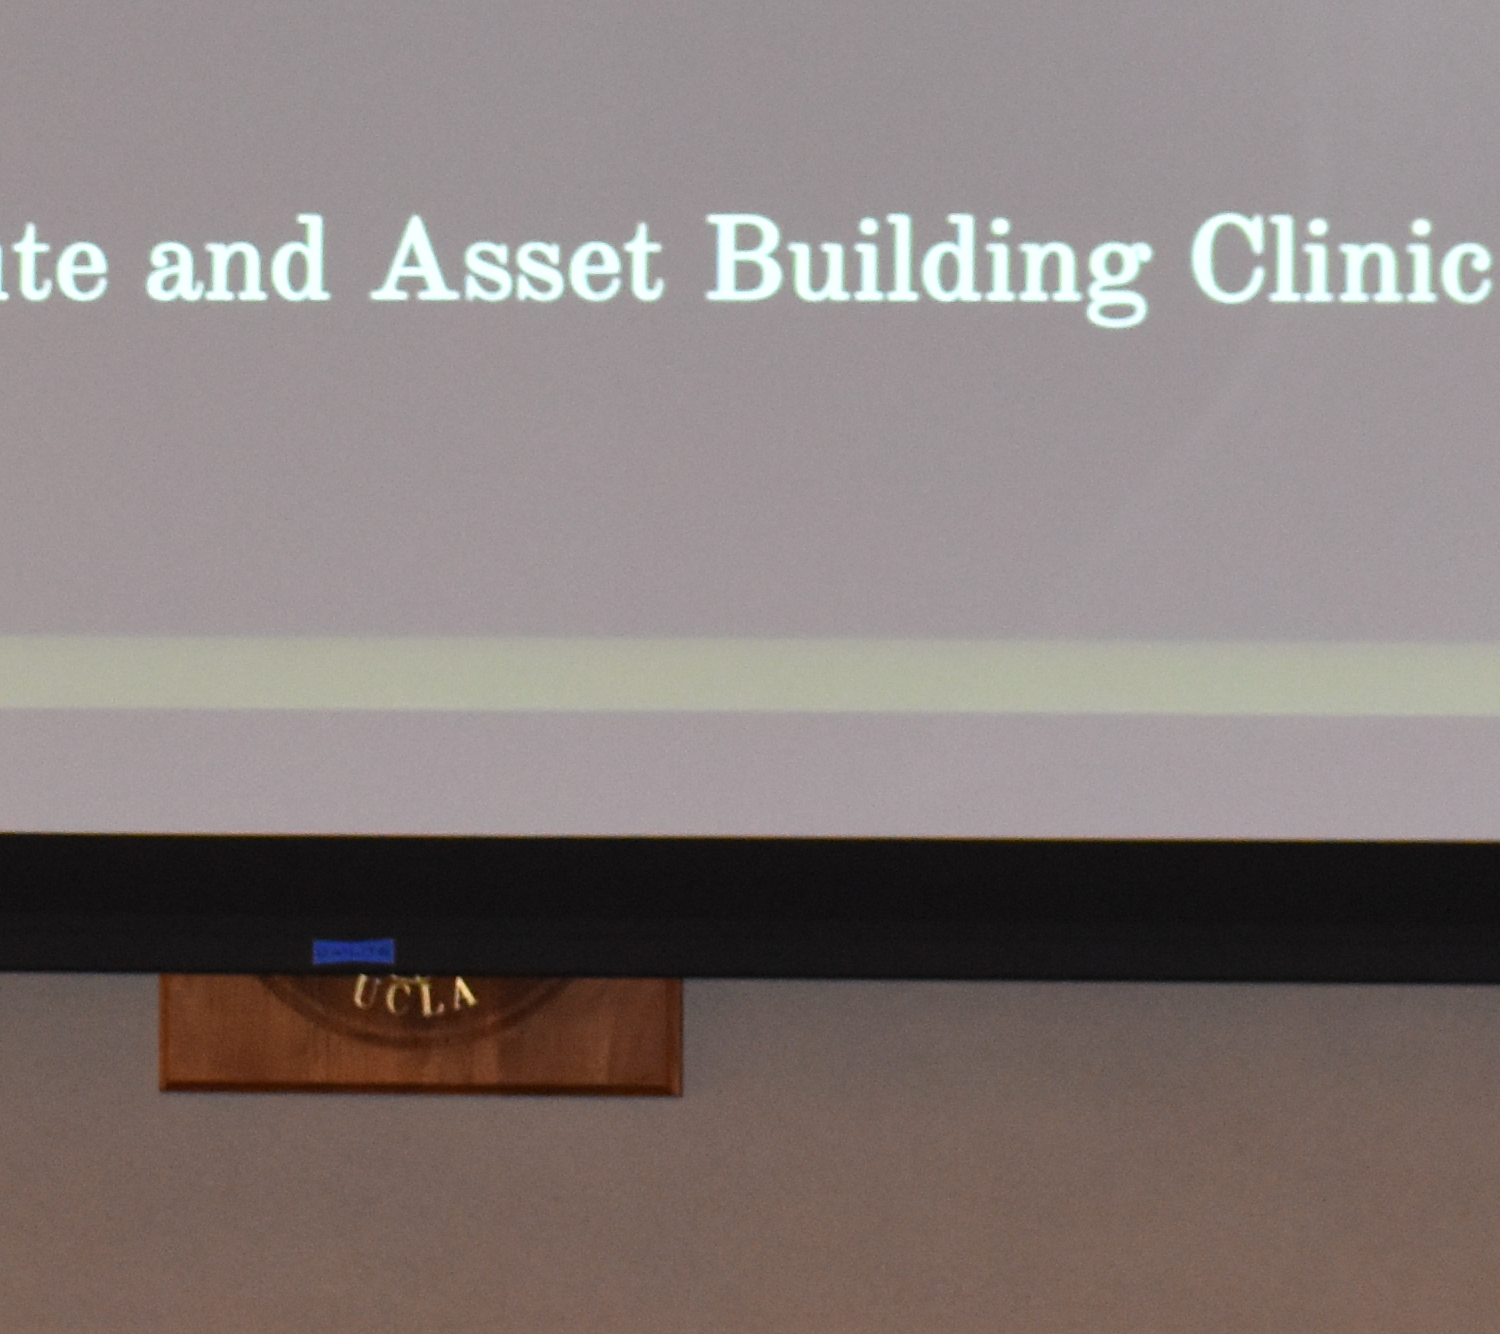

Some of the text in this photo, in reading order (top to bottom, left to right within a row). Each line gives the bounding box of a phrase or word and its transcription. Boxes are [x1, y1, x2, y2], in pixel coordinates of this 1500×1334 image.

[143, 211, 334, 305] and
[367, 212, 667, 305] Asset
[703, 209, 1156, 332] Building
[1188, 209, 1495, 307] Clinic
[354, 973, 478, 1017] UCLA
